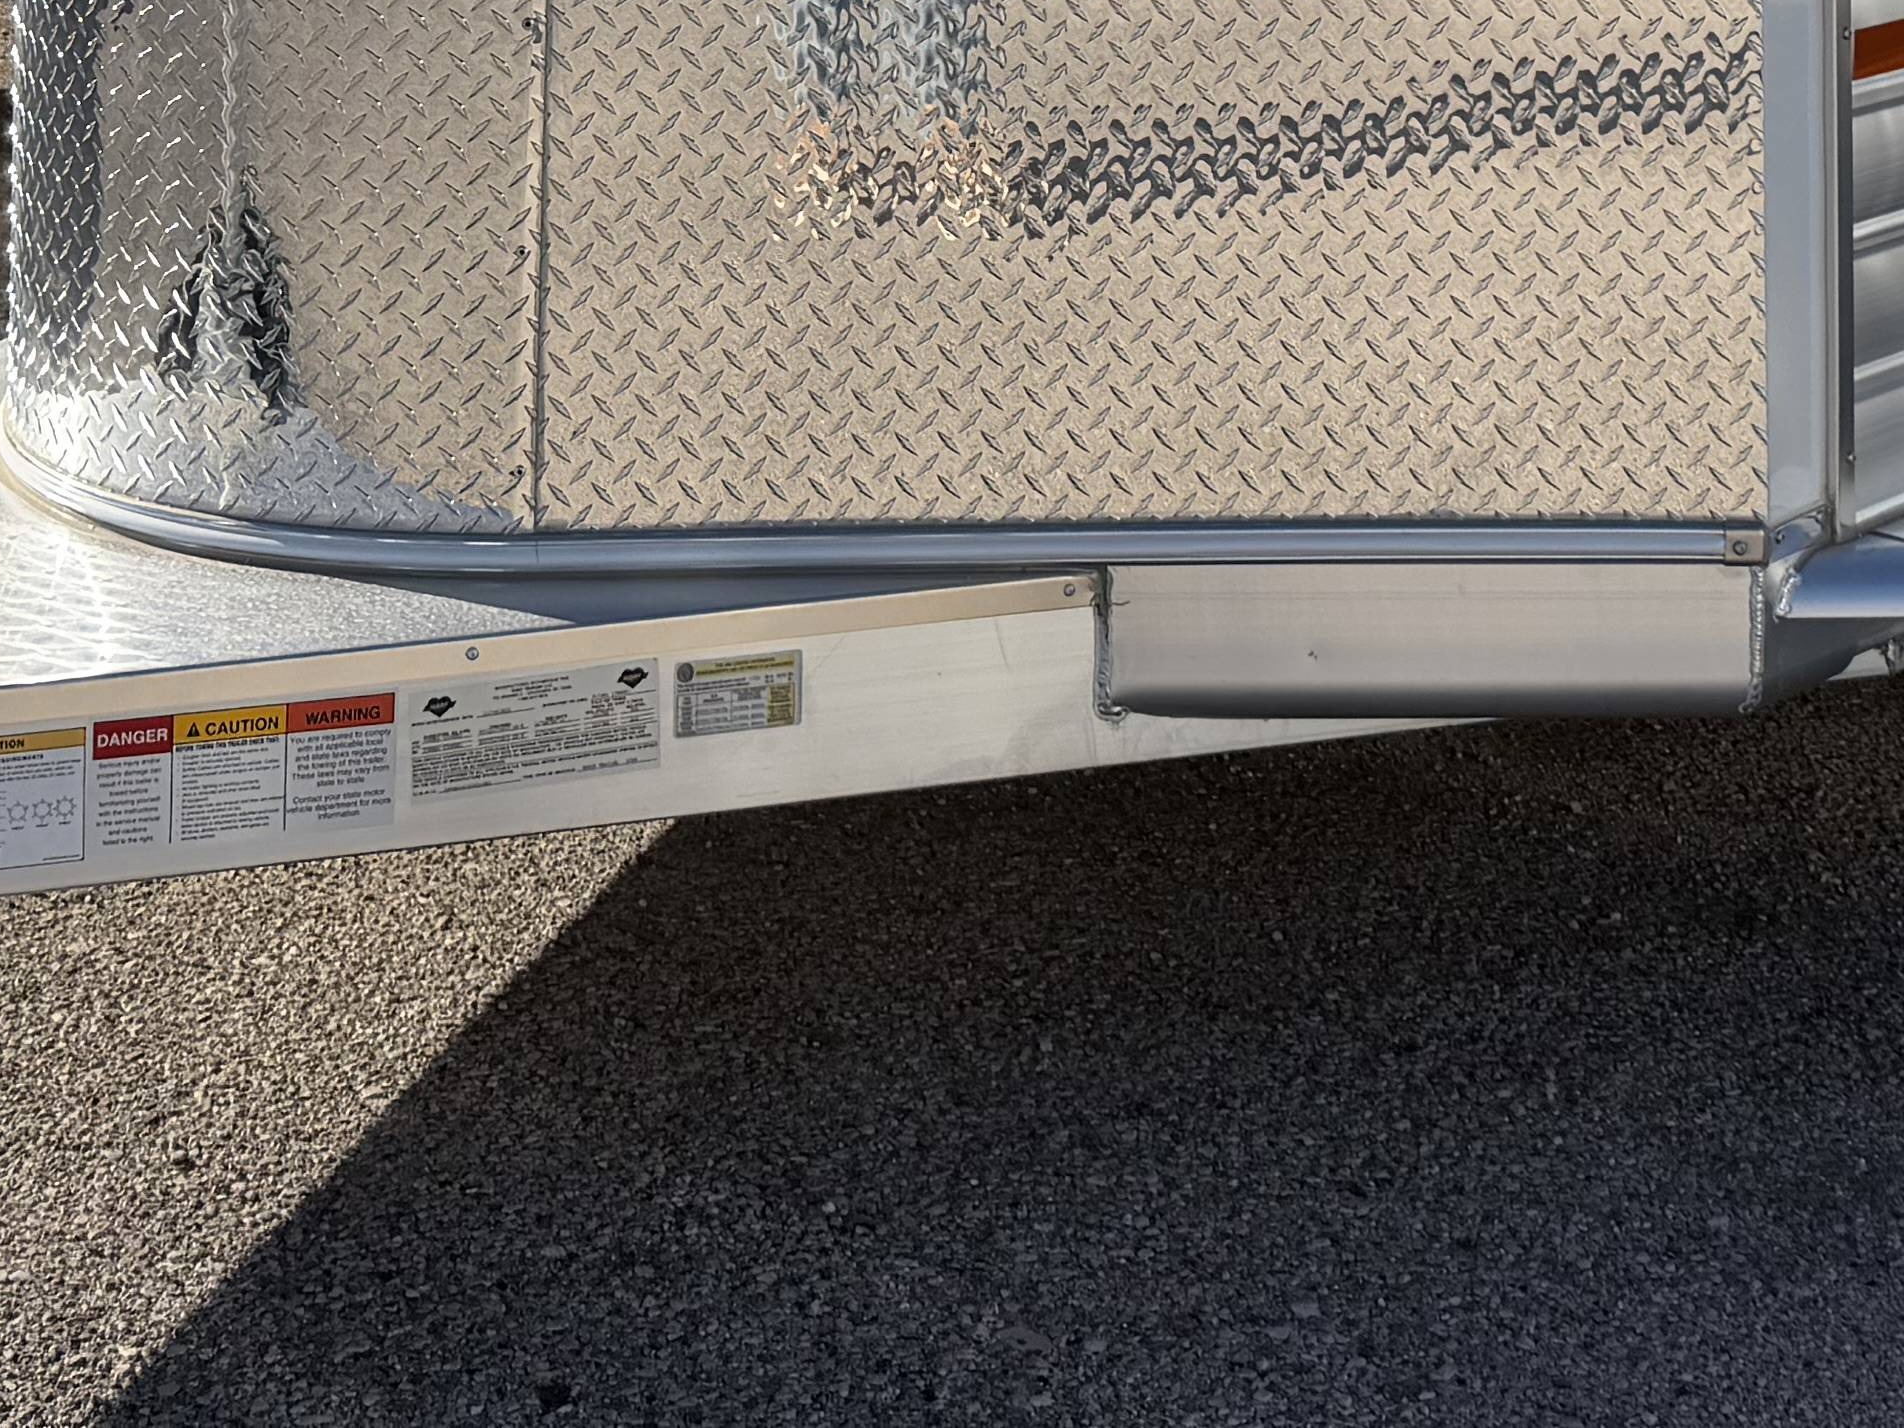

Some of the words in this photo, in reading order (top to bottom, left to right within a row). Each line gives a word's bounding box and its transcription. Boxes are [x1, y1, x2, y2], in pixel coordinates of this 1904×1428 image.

[305, 705, 381, 725] WARNING
[205, 716, 279, 736] CAUTION
[97, 727, 168, 748] DANGER
